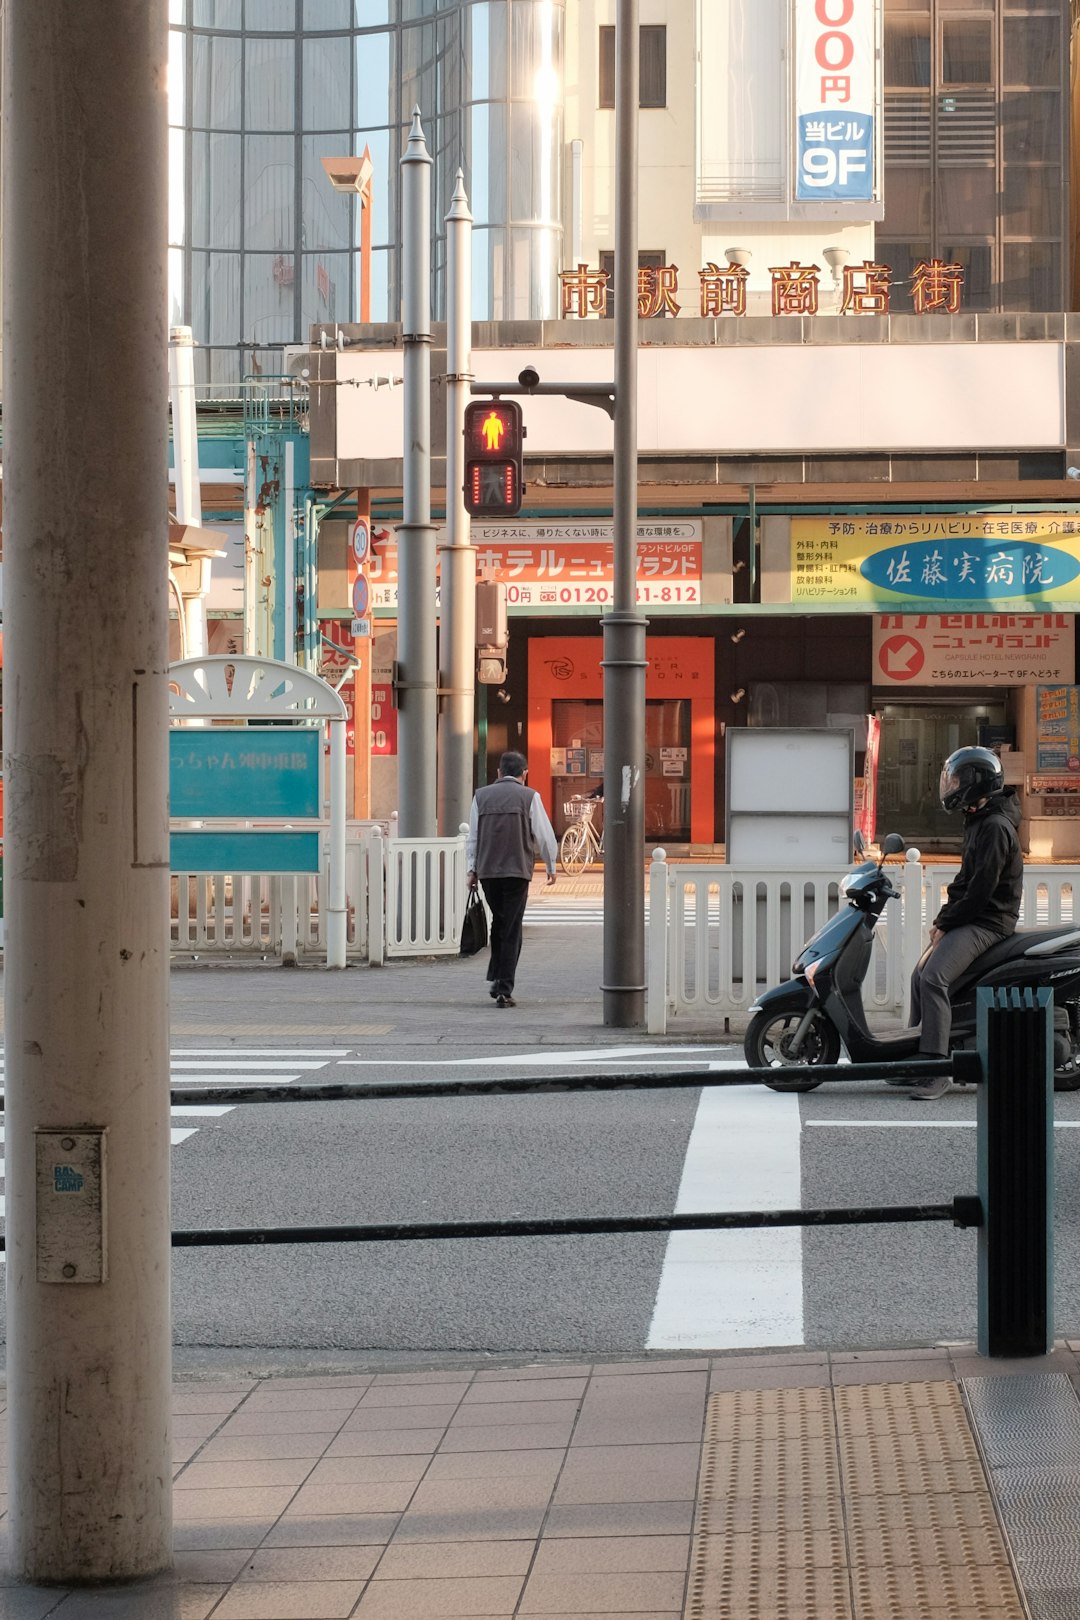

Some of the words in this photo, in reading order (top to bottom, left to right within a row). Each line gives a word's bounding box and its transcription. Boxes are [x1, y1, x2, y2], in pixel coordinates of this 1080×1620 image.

[804, 121, 864, 142] 当ビル
[802, 147, 867, 187] 9F
[355, 532, 366, 552] 30
[796, 541, 838, 550] 外科・内科
[796, 553, 833, 561] 整形外科
[886, 550, 1054, 586] 佐藤実病院
[796, 576, 833, 584] 放射線科
[796, 588, 857, 596] リハビリテーション科
[932, 634, 1060, 648] ニューグランド
[945, 653, 976, 661] CAPSULE
[979, 653, 1003, 661] HOTEL
